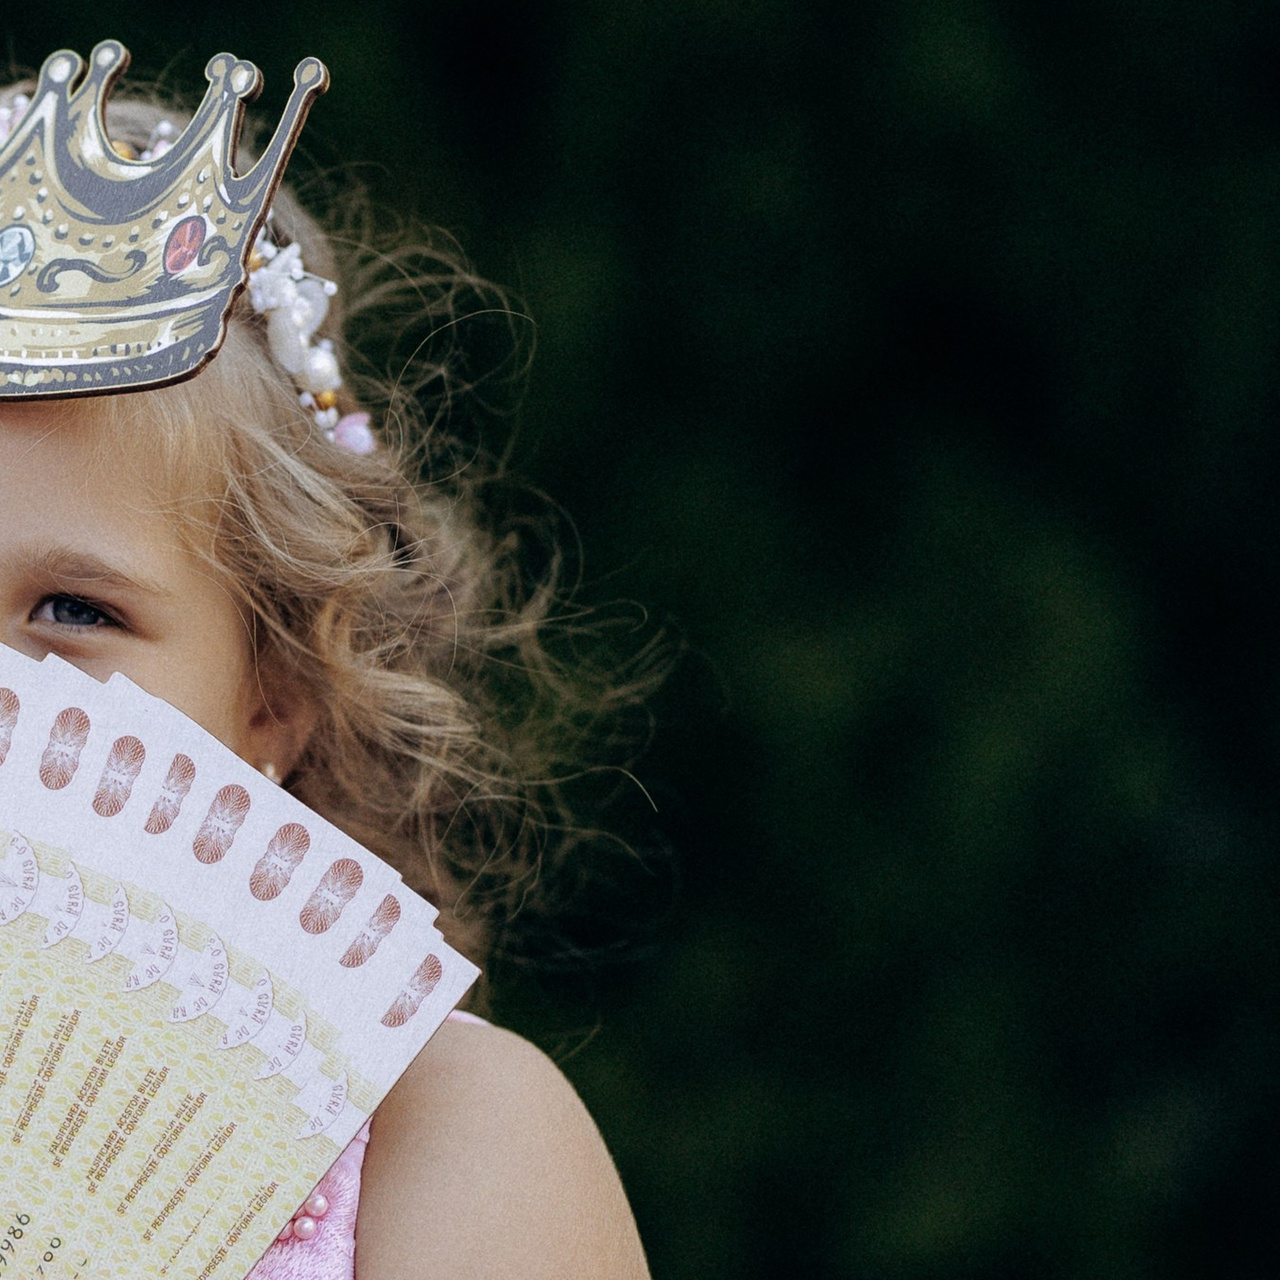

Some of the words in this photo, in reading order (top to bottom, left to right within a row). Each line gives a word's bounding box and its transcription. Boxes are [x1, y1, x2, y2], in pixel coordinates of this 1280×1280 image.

[2, 1028, 26, 1069] CONFORM
[20, 993, 40, 1027] LEGILOR
[12, 1131, 23, 1143] SE
[41, 1042, 65, 1083] CONFORM
[60, 1008, 81, 1042] LEGILOR
[48, 1101, 81, 1154] FALSIFICAREA
[75, 1065, 99, 1101] ACESTOR
[94, 1038, 113, 1065] BILETE
[53, 1155, 64, 1167] SE
[84, 1068, 110, 1108] CONFORM
[104, 1034, 127, 1068] LEGILOR
[88, 1181, 99, 1193] SE
[123, 1096, 150, 1136] CONFORM
[146, 1065, 170, 1098] LEGILOR
[115, 1093, 140, 1129] ACESTOR
[137, 1068, 157, 1094] BILETE
[116, 1202, 128, 1214] SE
[155, 1121, 186, 1159] CONFORM
[182, 1091, 208, 1123] LEGILOR
[142, 1229, 154, 1241] SE
[183, 1150, 214, 1188] CONFORM
[211, 1120, 237, 1152] LEGILOR
[225, 1210, 256, 1247] CONFORM
[252, 1180, 279, 1212] LEGILOR
